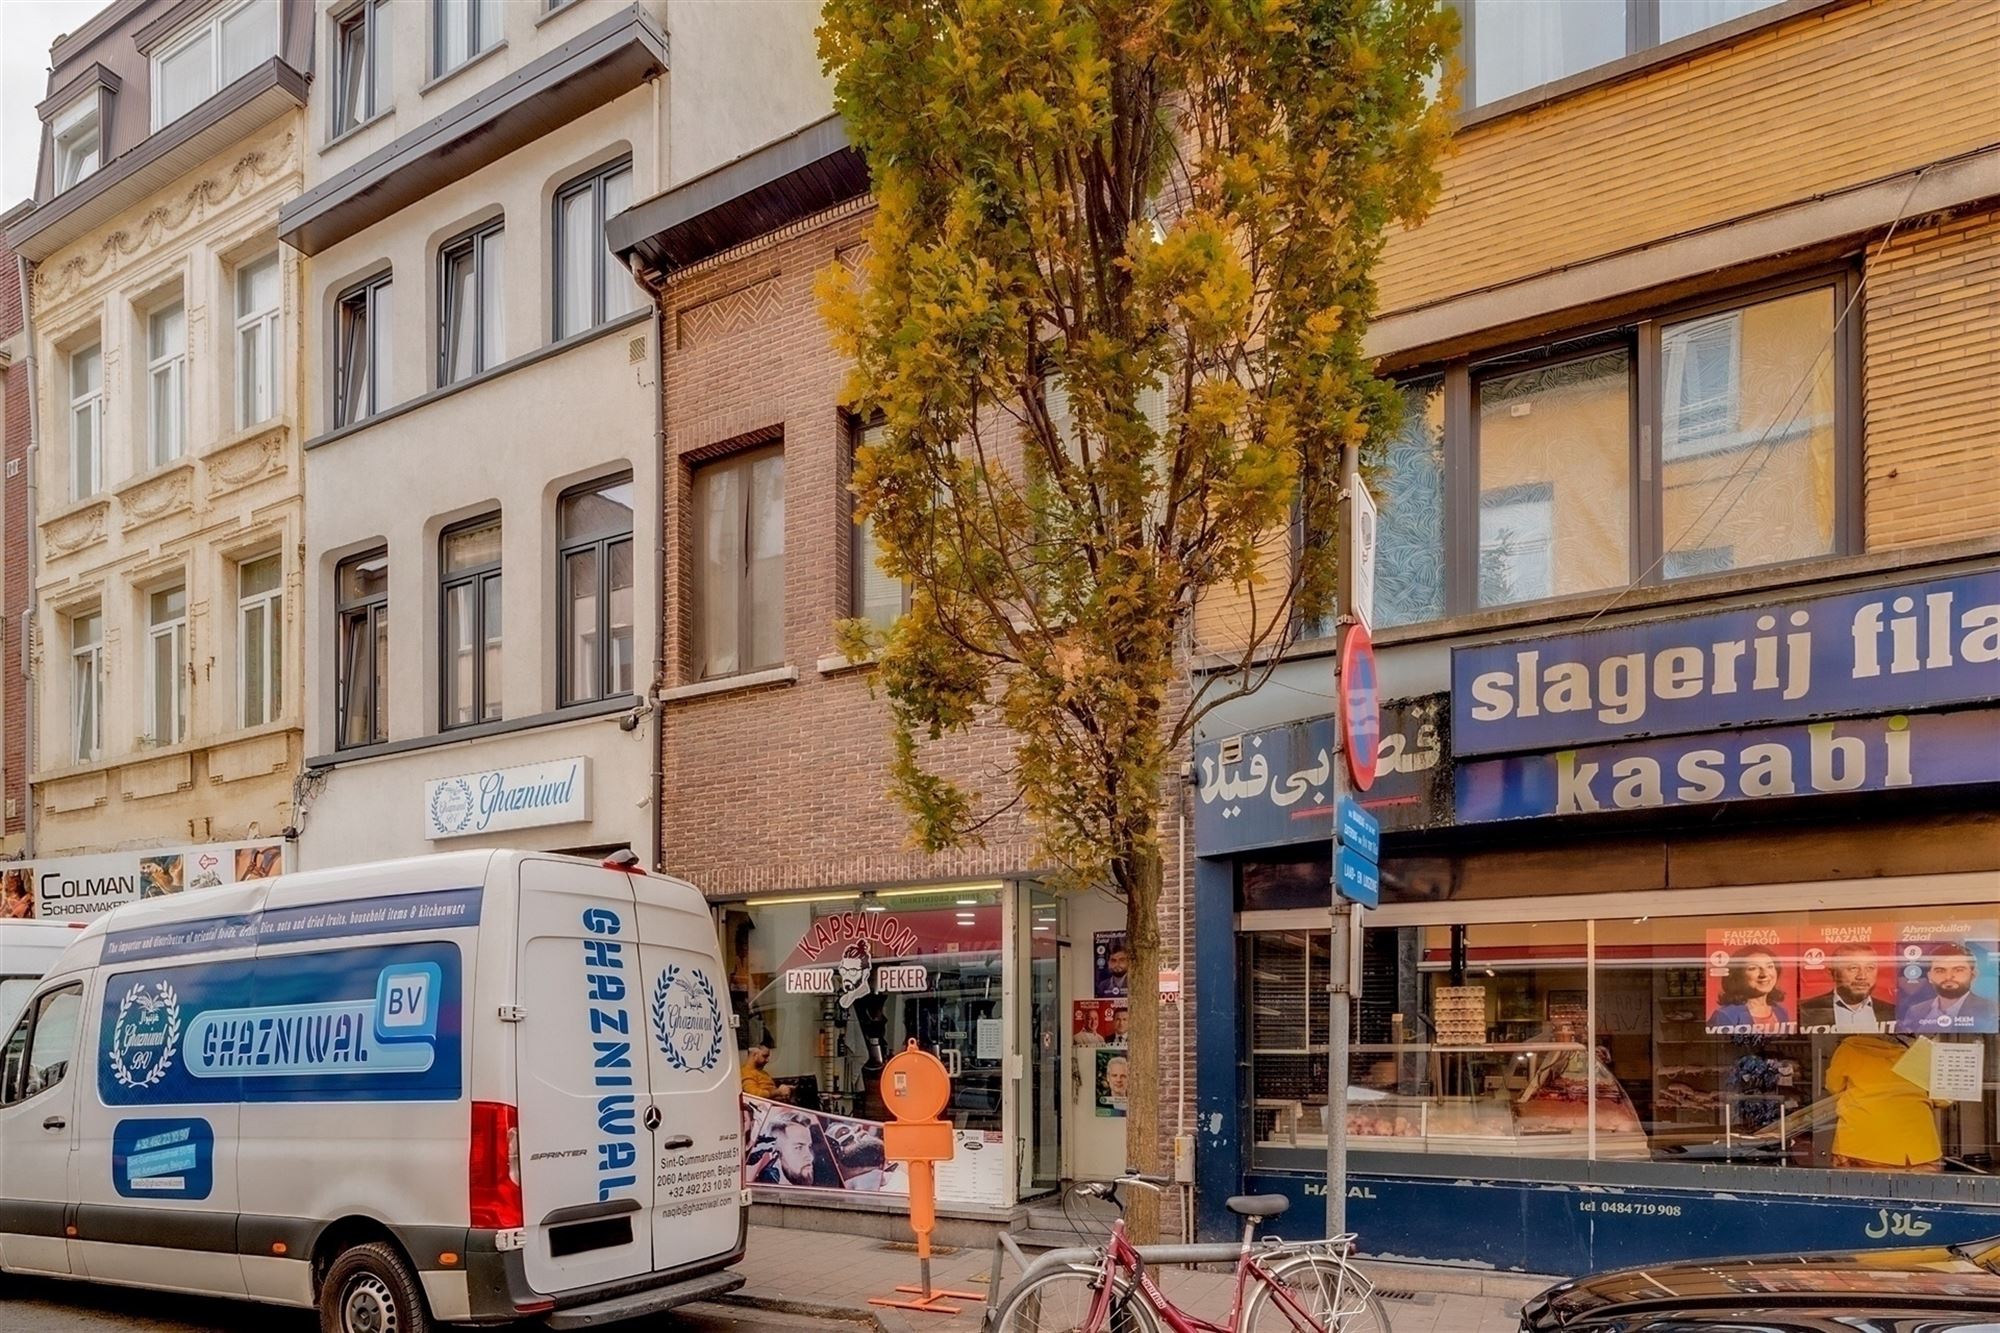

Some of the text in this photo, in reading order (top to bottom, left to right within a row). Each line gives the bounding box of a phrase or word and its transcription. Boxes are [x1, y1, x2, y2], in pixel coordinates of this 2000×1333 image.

[1471, 610, 1813, 725] slagerij
[1554, 714, 1913, 815] kasabi
[476, 764, 577, 830] Ghazniwal
[41, 873, 134, 899] COLMAN
[42, 901, 128, 916] SCHOENMAKE
[108, 942, 117, 953] The
[118, 939, 143, 955] importer
[142, 938, 152, 949] and
[154, 934, 184, 948] distributor
[186, 931, 194, 944] of
[293, 917, 305, 930] and
[307, 915, 324, 928] dried
[350, 908, 386, 924] household
[387, 907, 408, 920] items
[410, 906, 417, 919] &
[419, 903, 466, 918] kitchenware
[797, 911, 919, 962] KAPSALON
[1724, 930, 1777, 938] FAUZAYA
[1820, 926, 1872, 936] IBRAHIM
[1824, 934, 1871, 943] NAZARI
[1902, 923, 1972, 934] Ahmadullah
[1722, 937, 1780, 945] TALHAOUI
[787, 968, 926, 992] FARUK PEKER
[388, 986, 422, 1015] BV
[1705, 1021, 1798, 1035] VOORUIT
[203, 1013, 368, 1067] GHAZNIWAL
[583, 906, 637, 1202] GHAZNIWAL
[529, 1149, 588, 1161] SPRINTER
[660, 1148, 732, 1169] Sint-Gummarusstraat
[657, 1173, 677, 1187] 2060
[668, 1178, 732, 1198] +32 492 23 10 90
[1304, 1183, 1377, 1199] HAAL
[1579, 1200, 1596, 1212] tel
[1601, 1202, 1633, 1214] 0484
[1657, 1204, 1681, 1216] 908
